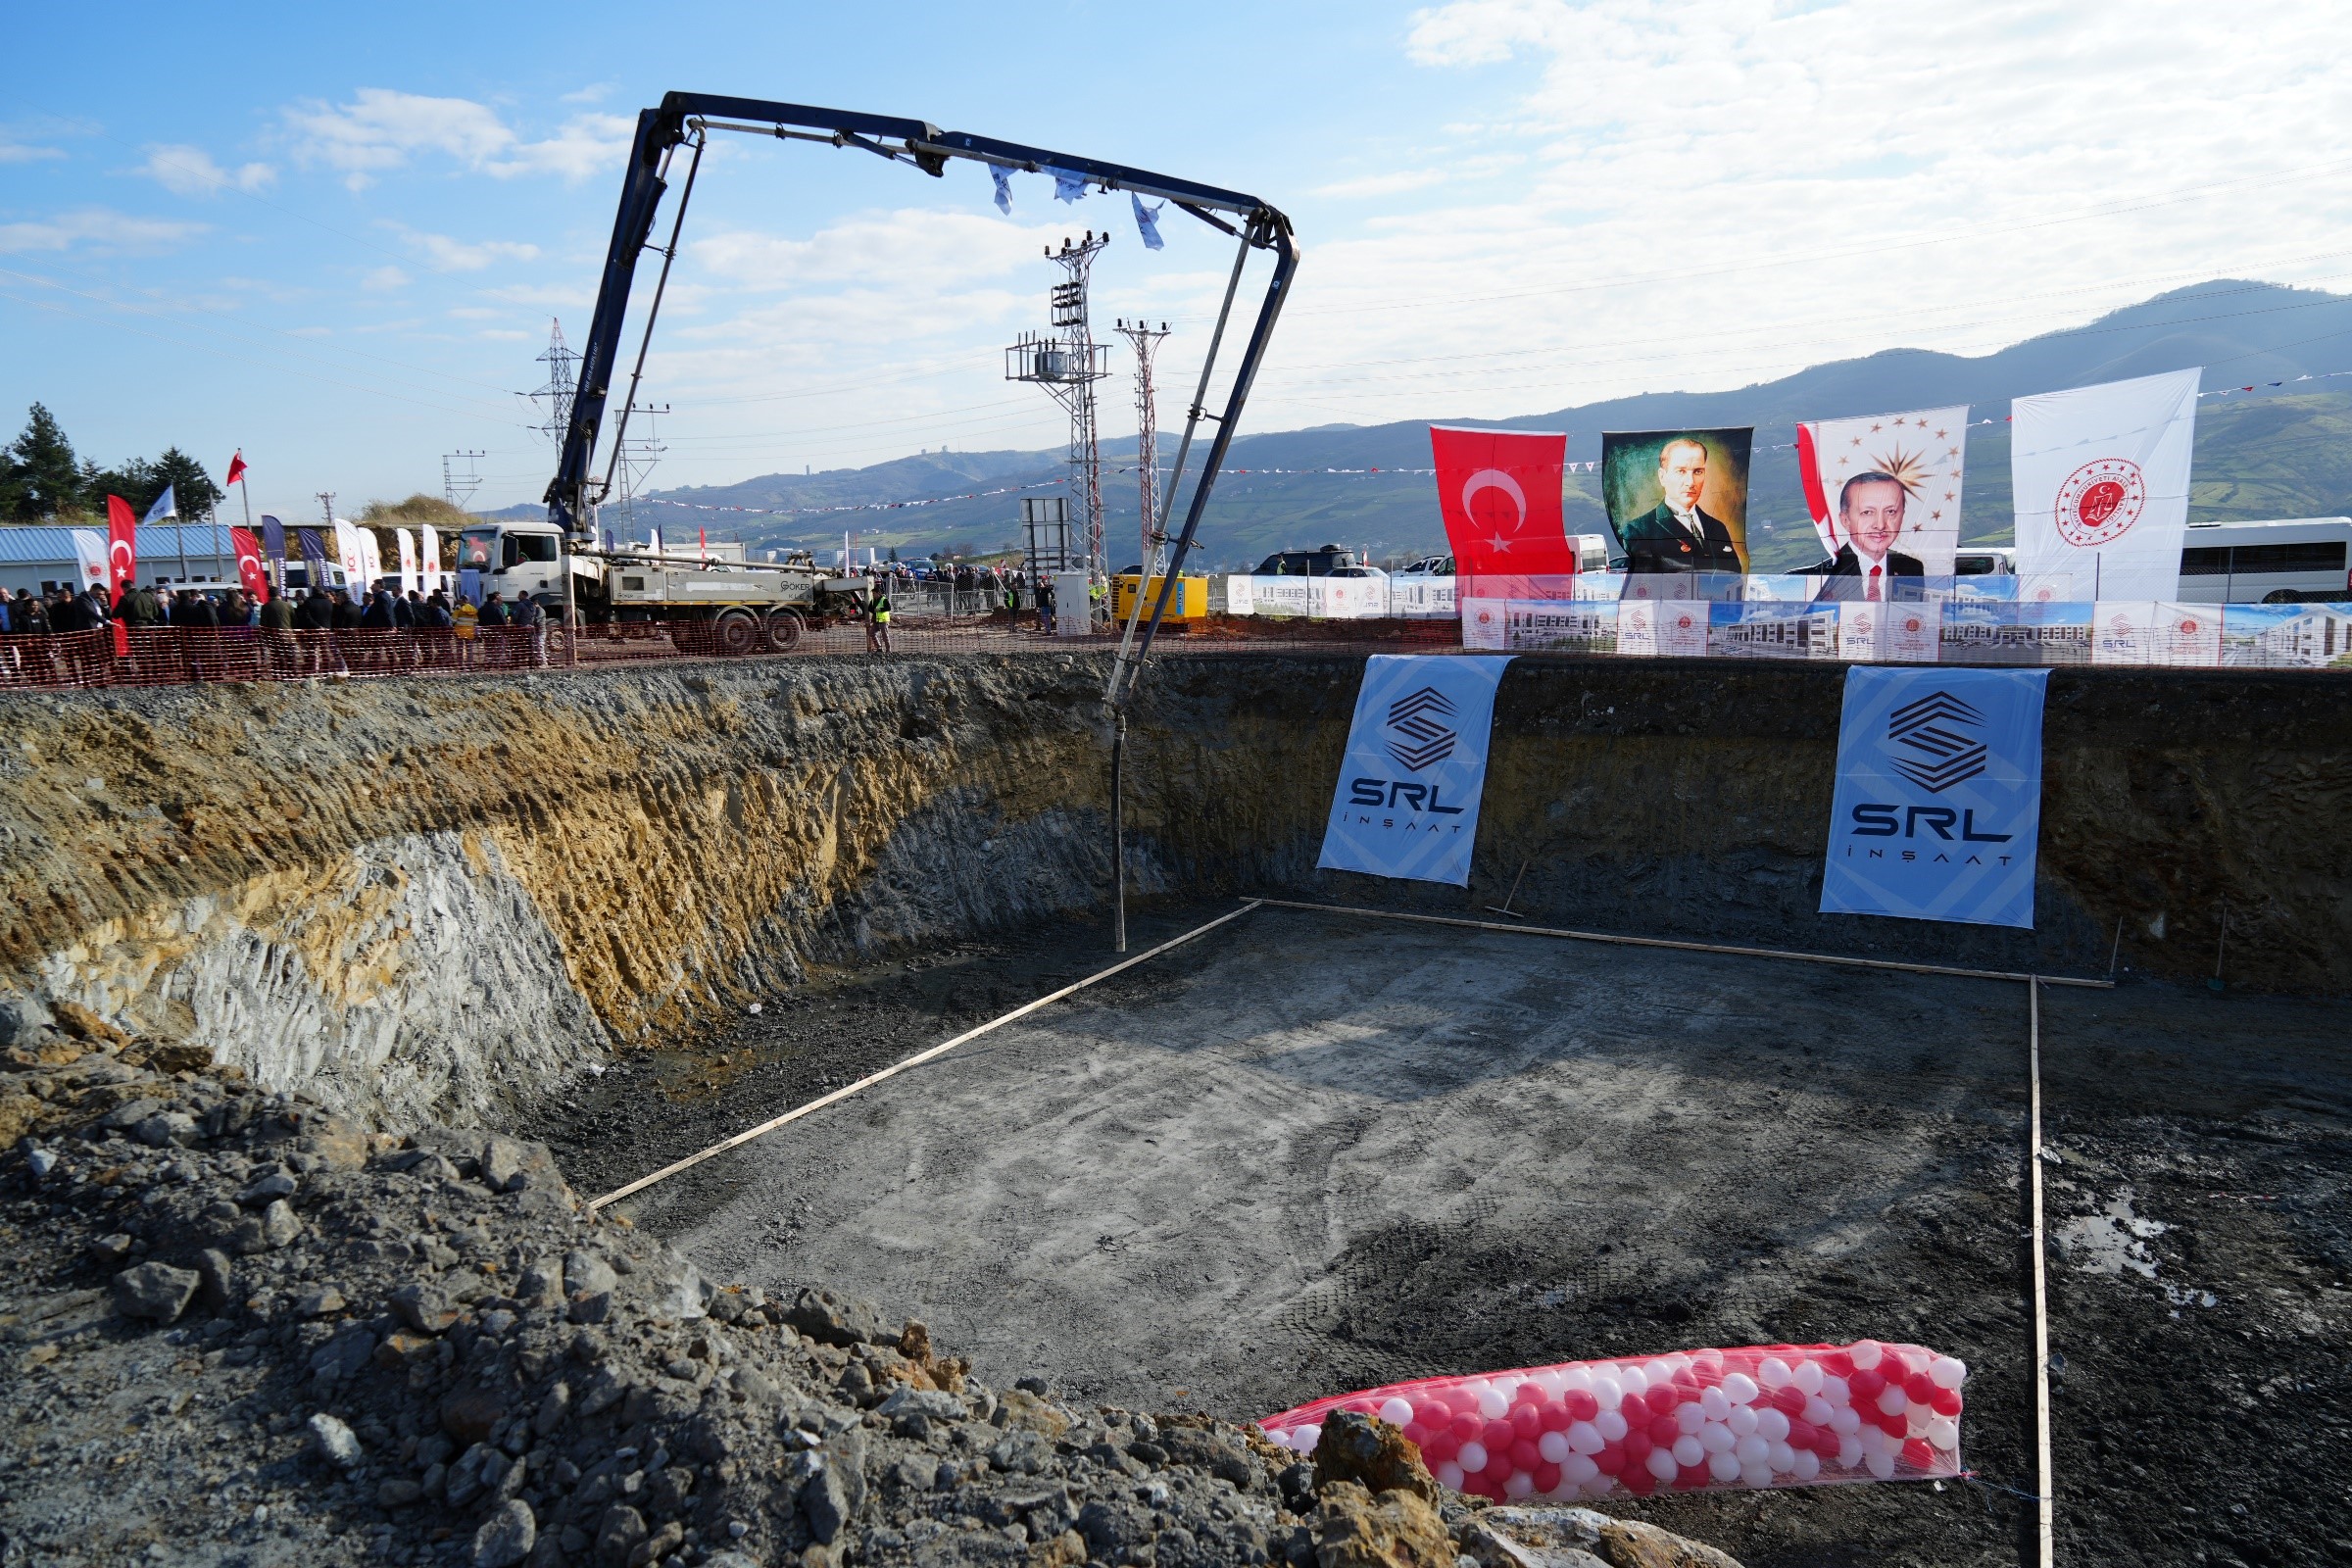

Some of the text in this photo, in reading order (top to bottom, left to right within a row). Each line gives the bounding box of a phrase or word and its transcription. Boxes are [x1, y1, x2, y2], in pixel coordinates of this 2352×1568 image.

[780, 580, 810, 592] GÖKER
[2102, 639, 2135, 648] SRL
[1348, 777, 1465, 815] SRL
[1850, 803, 2014, 843] SRL
